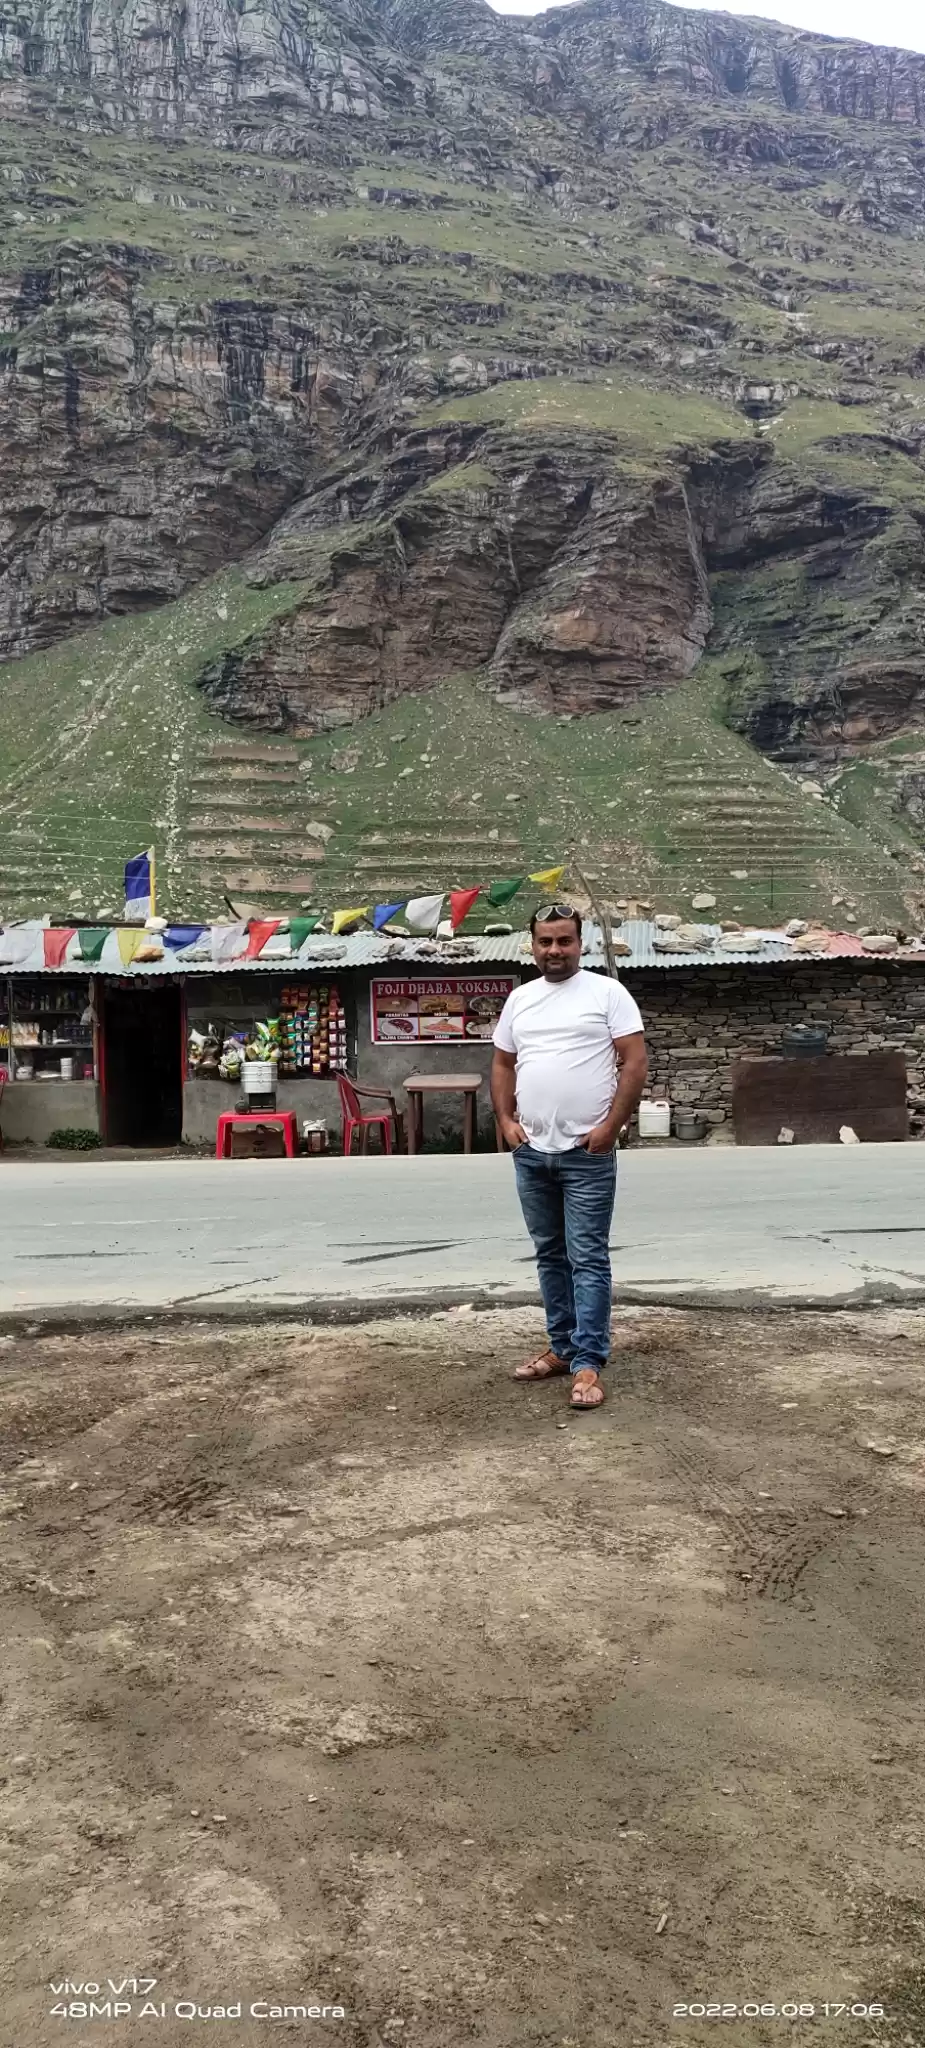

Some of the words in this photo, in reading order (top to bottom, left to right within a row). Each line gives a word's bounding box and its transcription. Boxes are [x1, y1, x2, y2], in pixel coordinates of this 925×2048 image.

[377, 983, 404, 995] FOJI
[409, 982, 453, 994] DHABA
[456, 981, 509, 994] KOKSAR
